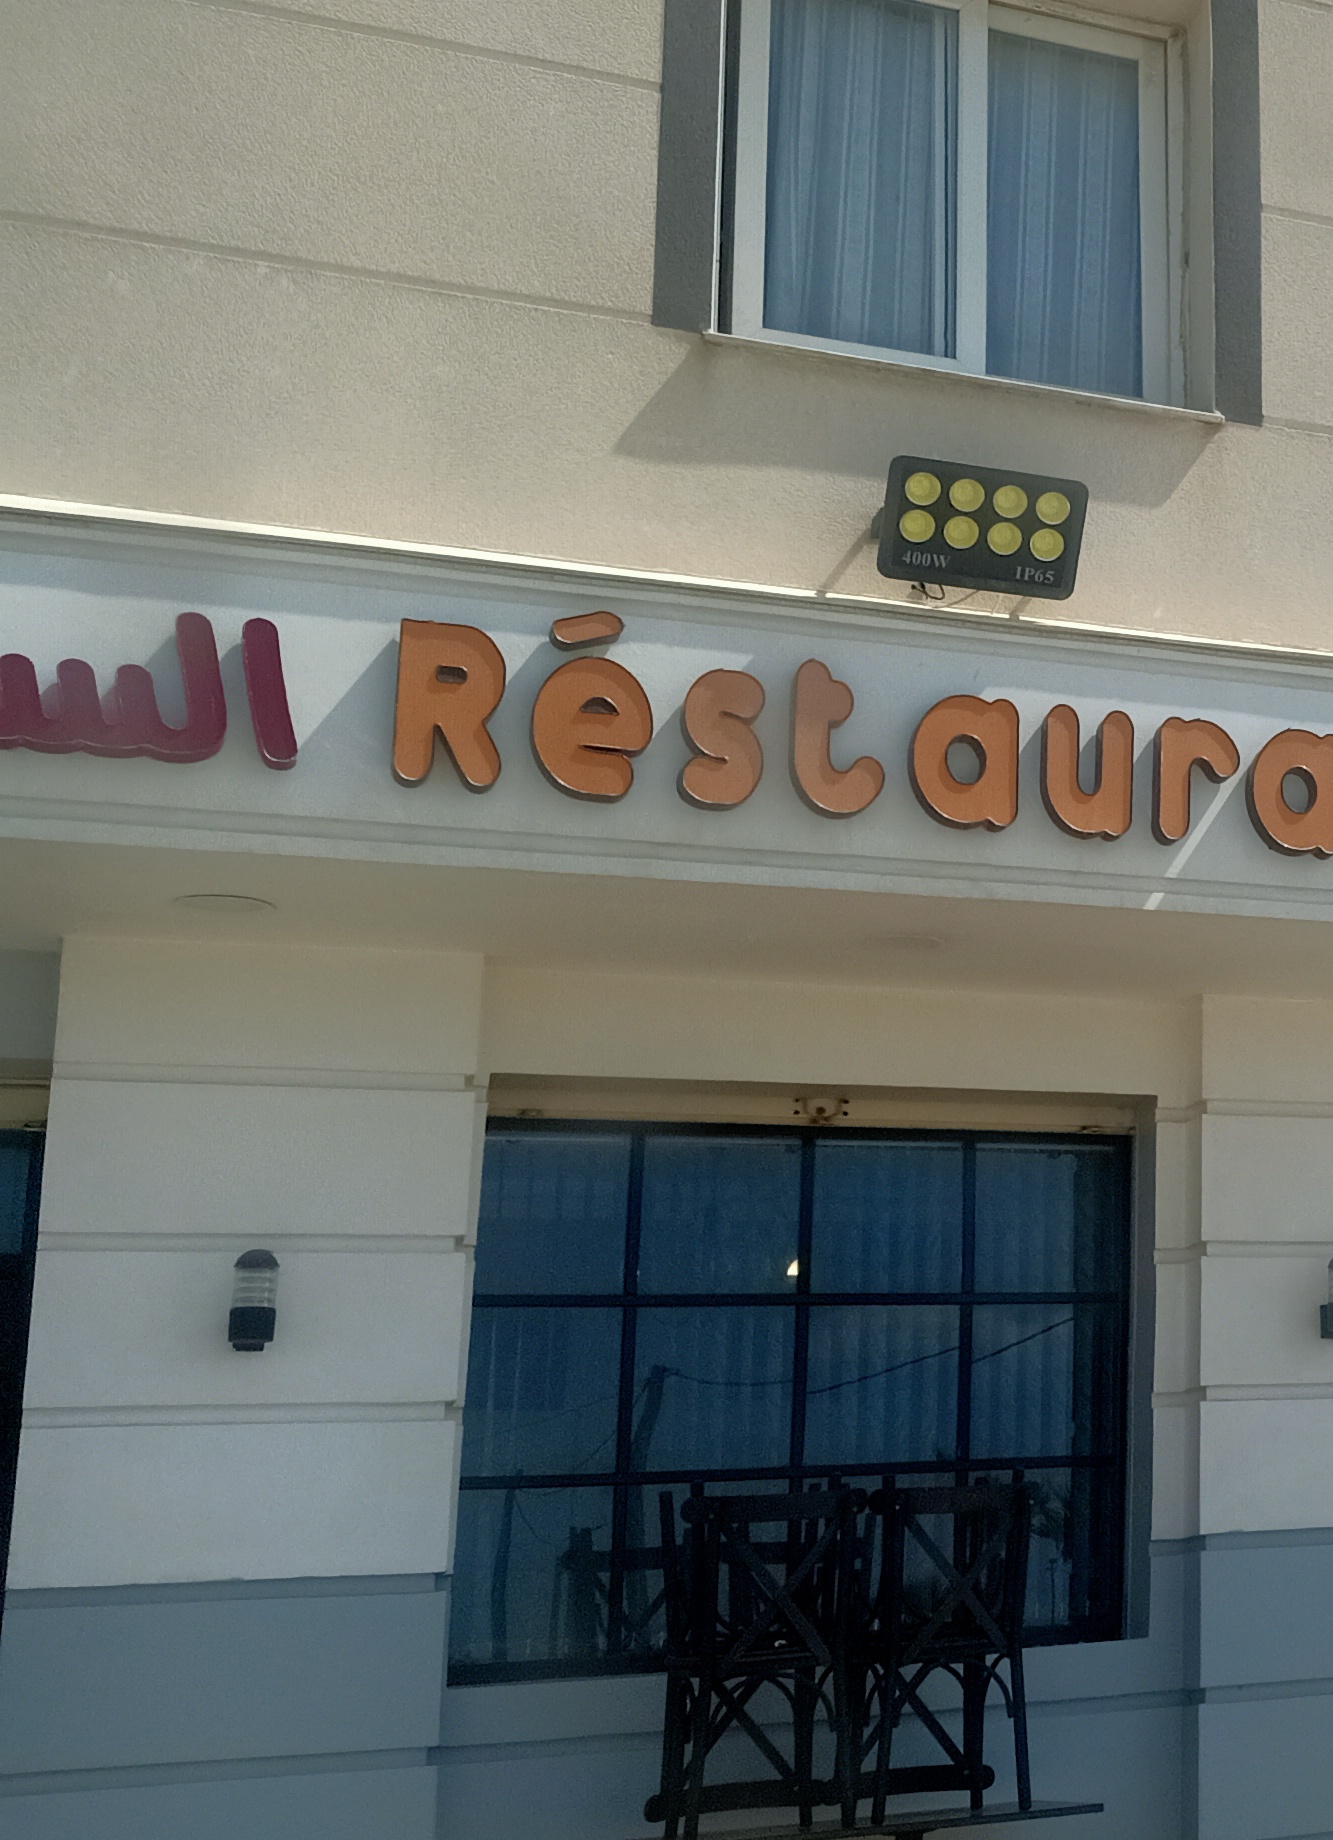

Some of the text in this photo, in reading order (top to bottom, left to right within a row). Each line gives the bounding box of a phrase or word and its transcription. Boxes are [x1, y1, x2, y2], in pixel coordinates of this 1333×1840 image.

[901, 549, 951, 570] 400W
[1014, 565, 1056, 585] IP65
[0, 611, 298, 771] الس
